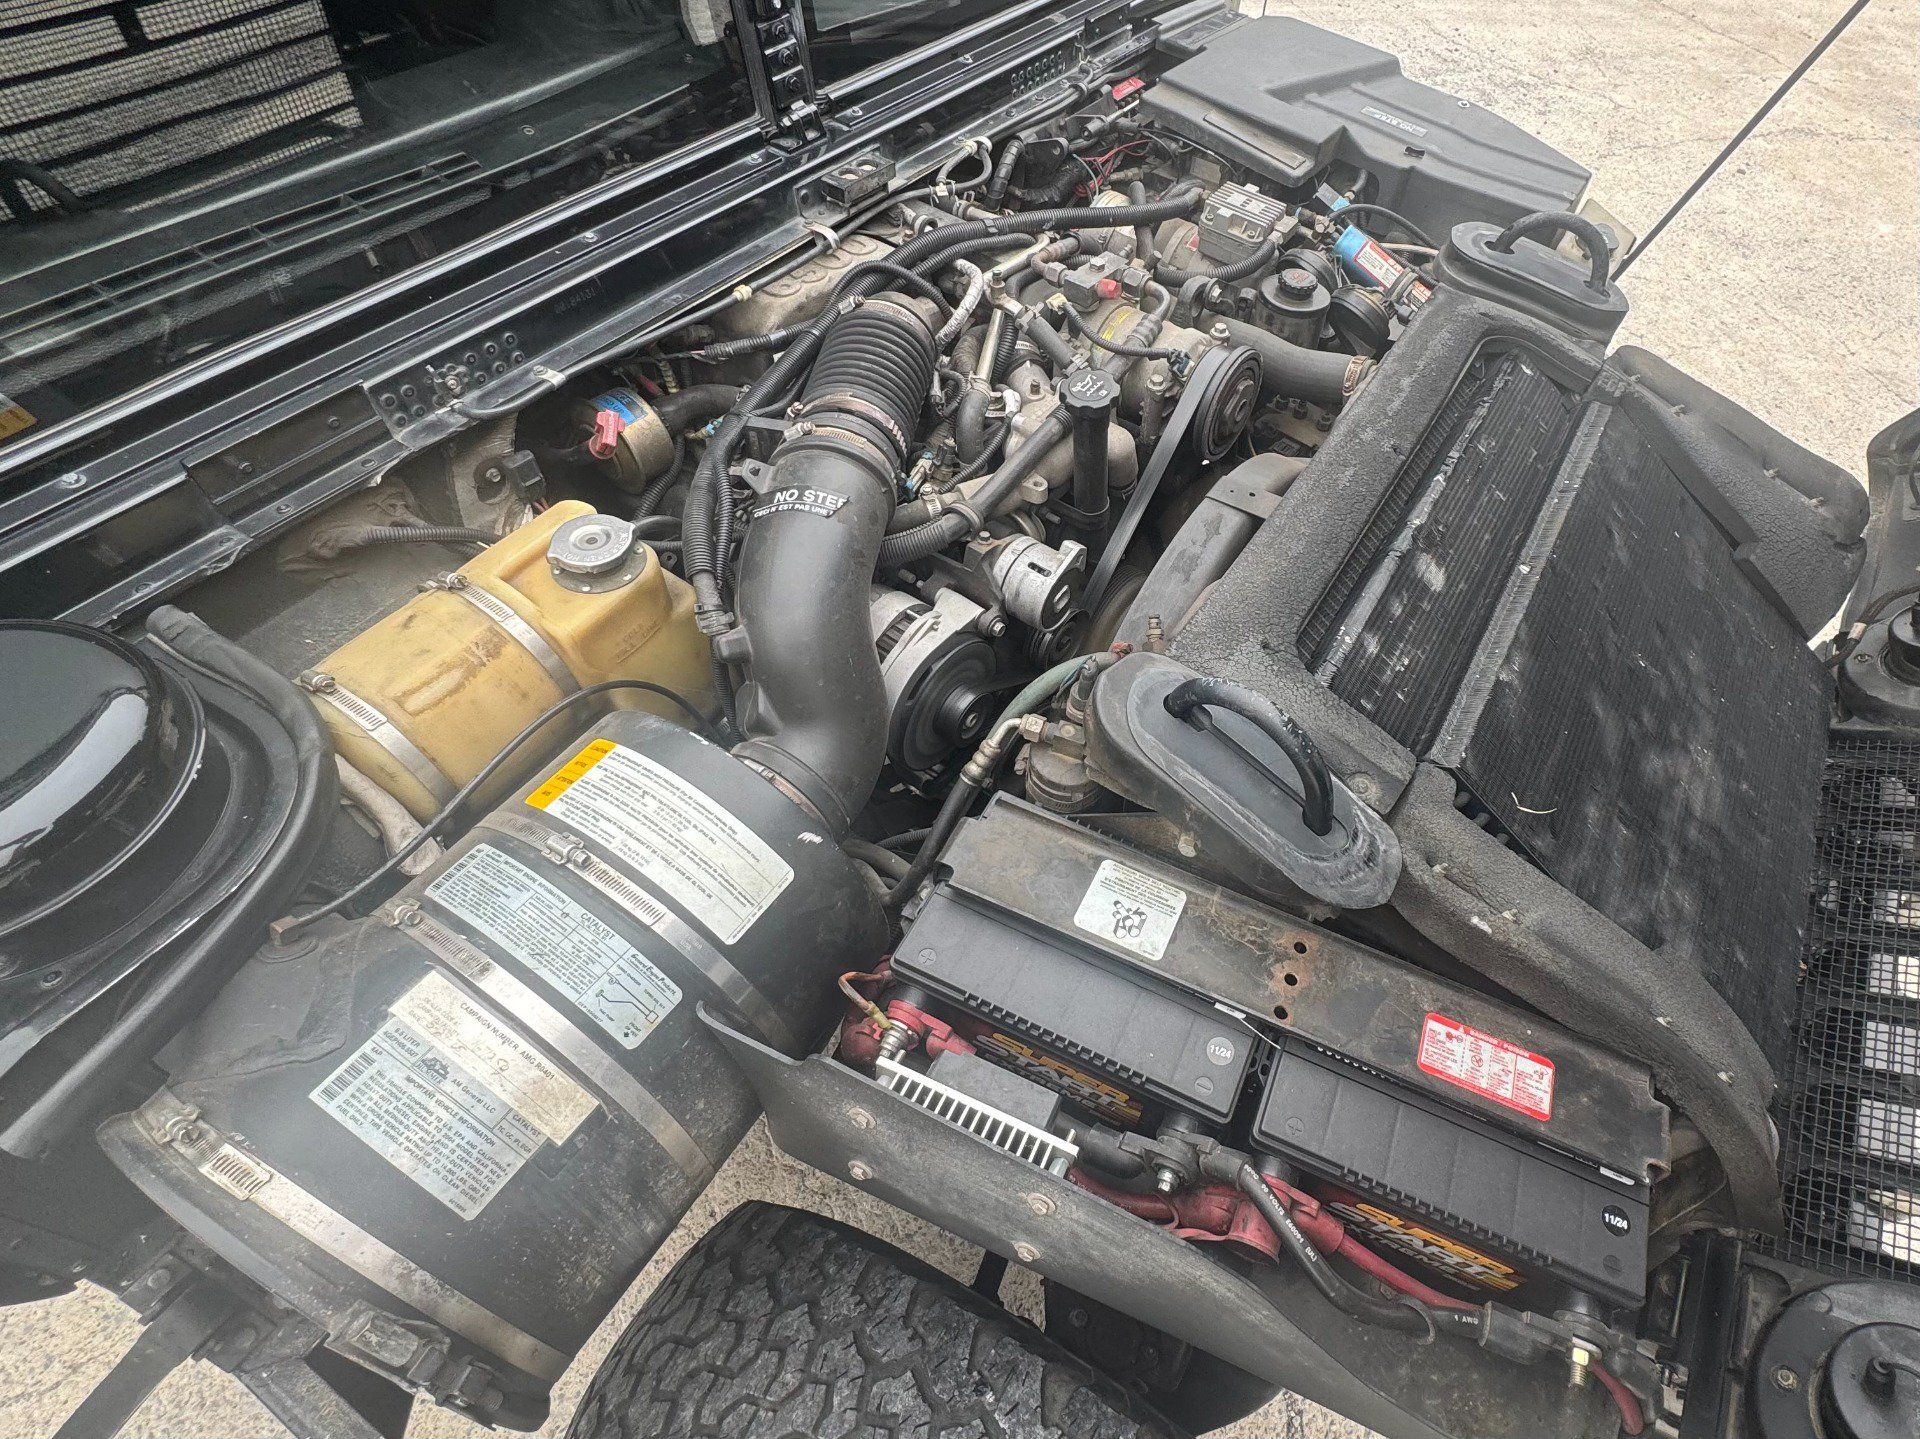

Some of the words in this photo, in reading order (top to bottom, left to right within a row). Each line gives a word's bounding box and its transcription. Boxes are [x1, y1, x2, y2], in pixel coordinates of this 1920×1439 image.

[754, 509, 768, 517] CECI
[811, 506, 827, 514] UNE
[773, 489, 798, 502] NO
[579, 912, 616, 940] CATALYST
[402, 1033, 421, 1049] LITER
[458, 1001, 493, 1029] CAMPAIGN
[489, 1026, 519, 1051] NUMBER
[518, 1049, 536, 1065] AMG
[533, 1061, 555, 1080] R0401
[1210, 1044, 1231, 1058] 11/24
[973, 1033, 1128, 1113] START
[989, 1031, 1131, 1104] SUPER
[334, 1103, 350, 1117] FUEL
[367, 1074, 402, 1103] REGULATIONS
[401, 1100, 434, 1127] APPLICABLE
[432, 1125, 442, 1134] TO
[403, 1074, 436, 1101] IMPORTANT
[434, 1097, 459, 1118] VEHICLE
[456, 1115, 496, 1148] INFORMATION
[450, 1077, 462, 1088] AM
[460, 1084, 484, 1105] General
[482, 1101, 496, 1114] LLC
[366, 1105, 385, 1121] GROSS
[383, 1118, 405, 1137] VEHICLE
[403, 1134, 424, 1152] RATING
[433, 1114, 443, 1124] TO
[453, 1130, 466, 1141] EPA
[465, 1139, 478, 1150] AND
[511, 1113, 541, 1138] CATALYST
[368, 1118, 382, 1131] THIS
[381, 1128, 404, 1147] VEHICLE
[402, 1144, 432, 1169] OPERATES
[431, 1166, 442, 1176] ON
[440, 1173, 460, 1190] CLEAN
[459, 1187, 479, 1205] DIESEL
[392, 1104, 412, 1121] DIESEL
[435, 1137, 449, 1150] AND
[448, 1147, 456, 1155] IS
[455, 1153, 484, 1176] CERTIFIED
[483, 1174, 496, 1186] FOR
[464, 1170, 490, 1192] VEHICLES
[1267, 1193, 1285, 1216] VOLTS
[1604, 1213, 1626, 1229] 11/24
[1328, 1196, 1504, 1287] START
[1354, 1198, 1514, 1281] SUPER
[1462, 1315, 1478, 1324] AWG
